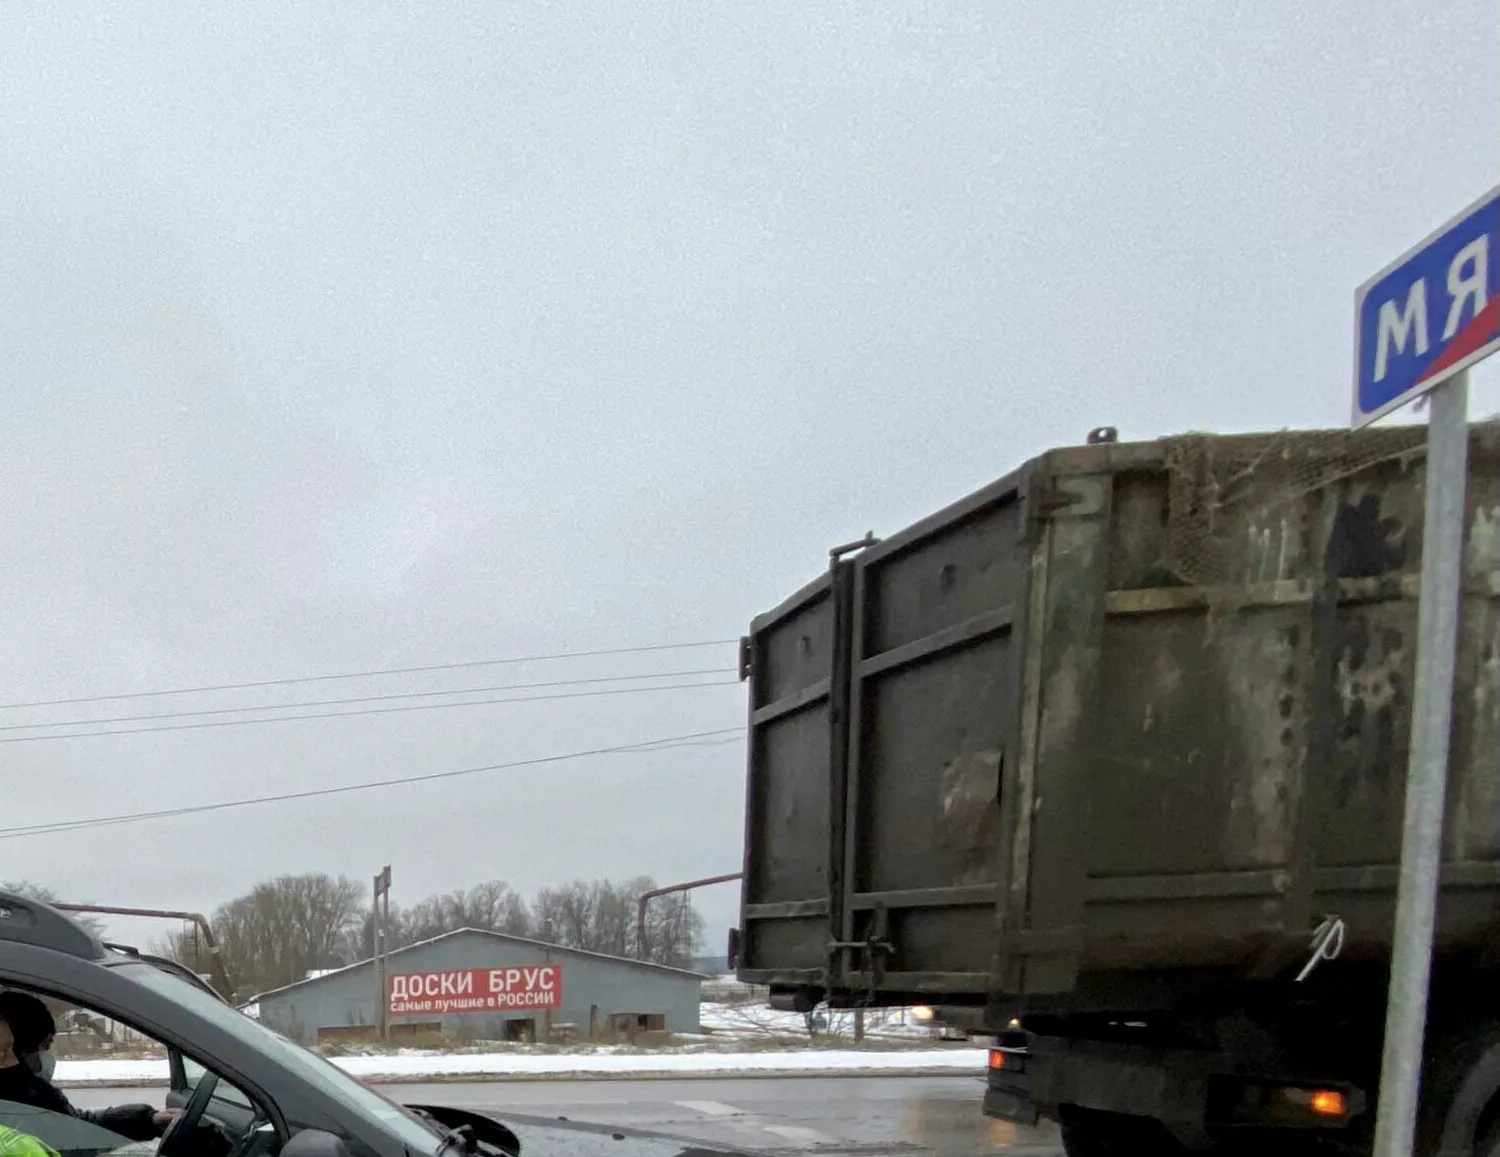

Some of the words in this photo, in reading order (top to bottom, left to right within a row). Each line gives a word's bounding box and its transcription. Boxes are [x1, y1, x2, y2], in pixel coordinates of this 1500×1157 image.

[390, 971, 473, 1001] ДОСКИ
[488, 967, 554, 993] БРУС
[390, 1000, 432, 1012] самые
[434, 997, 485, 1013] лучшие
[487, 997, 495, 1008] в
[498, 991, 554, 1006] РОССИИ
